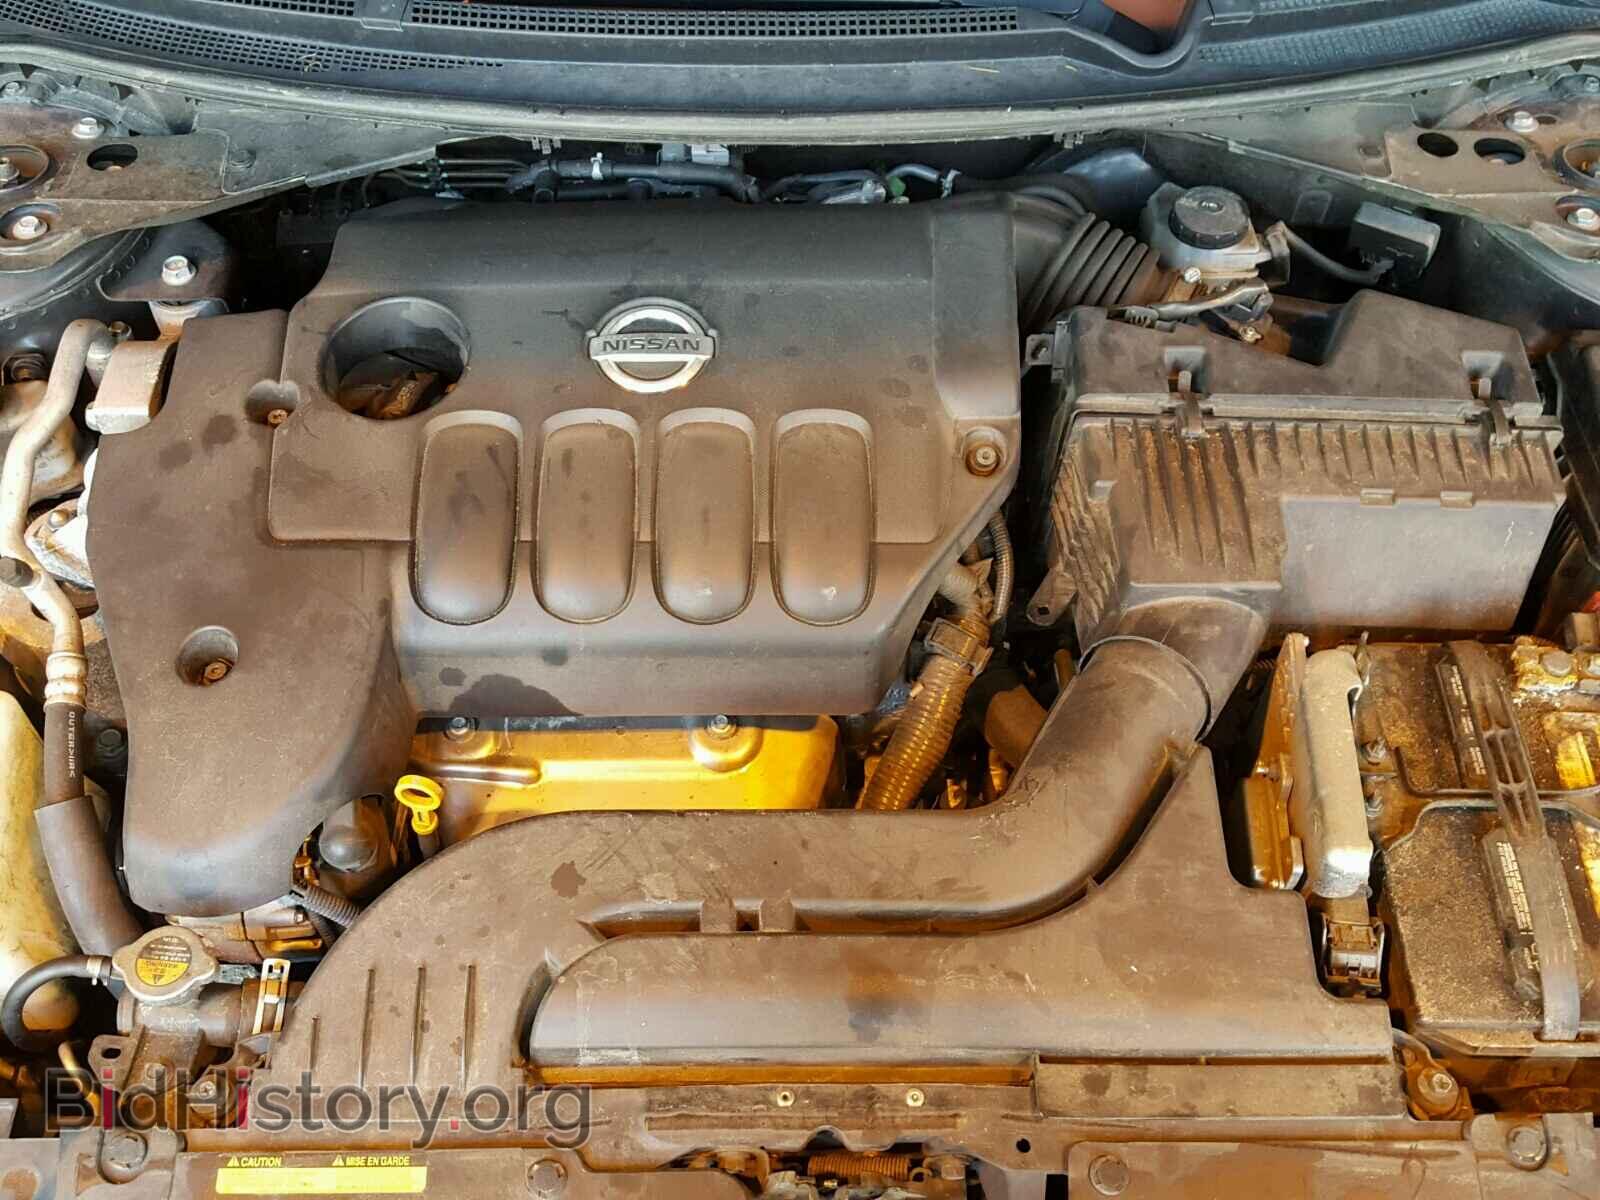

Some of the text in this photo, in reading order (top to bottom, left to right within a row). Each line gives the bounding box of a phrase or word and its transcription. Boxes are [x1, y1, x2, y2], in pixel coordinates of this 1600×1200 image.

[602, 338, 700, 352] NISSAN
[240, 1156, 282, 1167] CAUTION
[345, 1155, 410, 1167] MISE EN GARDE
